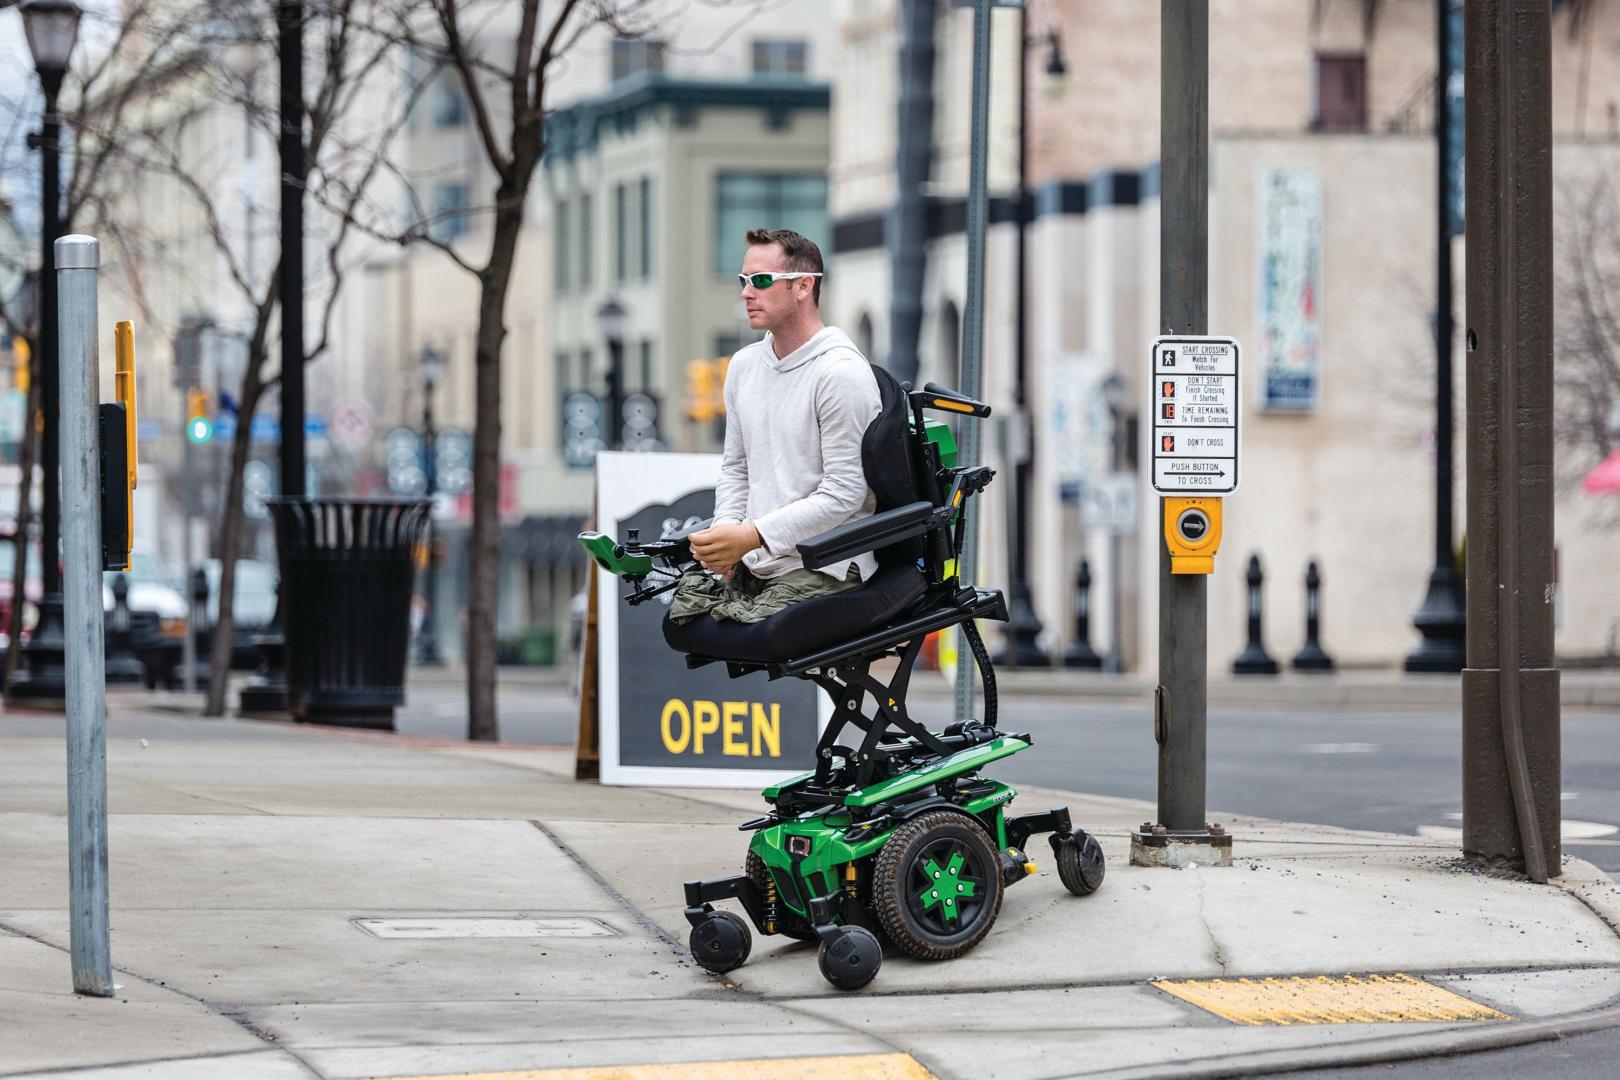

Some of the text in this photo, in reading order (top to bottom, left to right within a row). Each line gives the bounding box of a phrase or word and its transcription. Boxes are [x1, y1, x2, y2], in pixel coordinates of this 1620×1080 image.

[1204, 386, 1225, 396] Crossing
[1208, 416, 1229, 424] Crossing
[661, 698, 781, 757] OPEN
